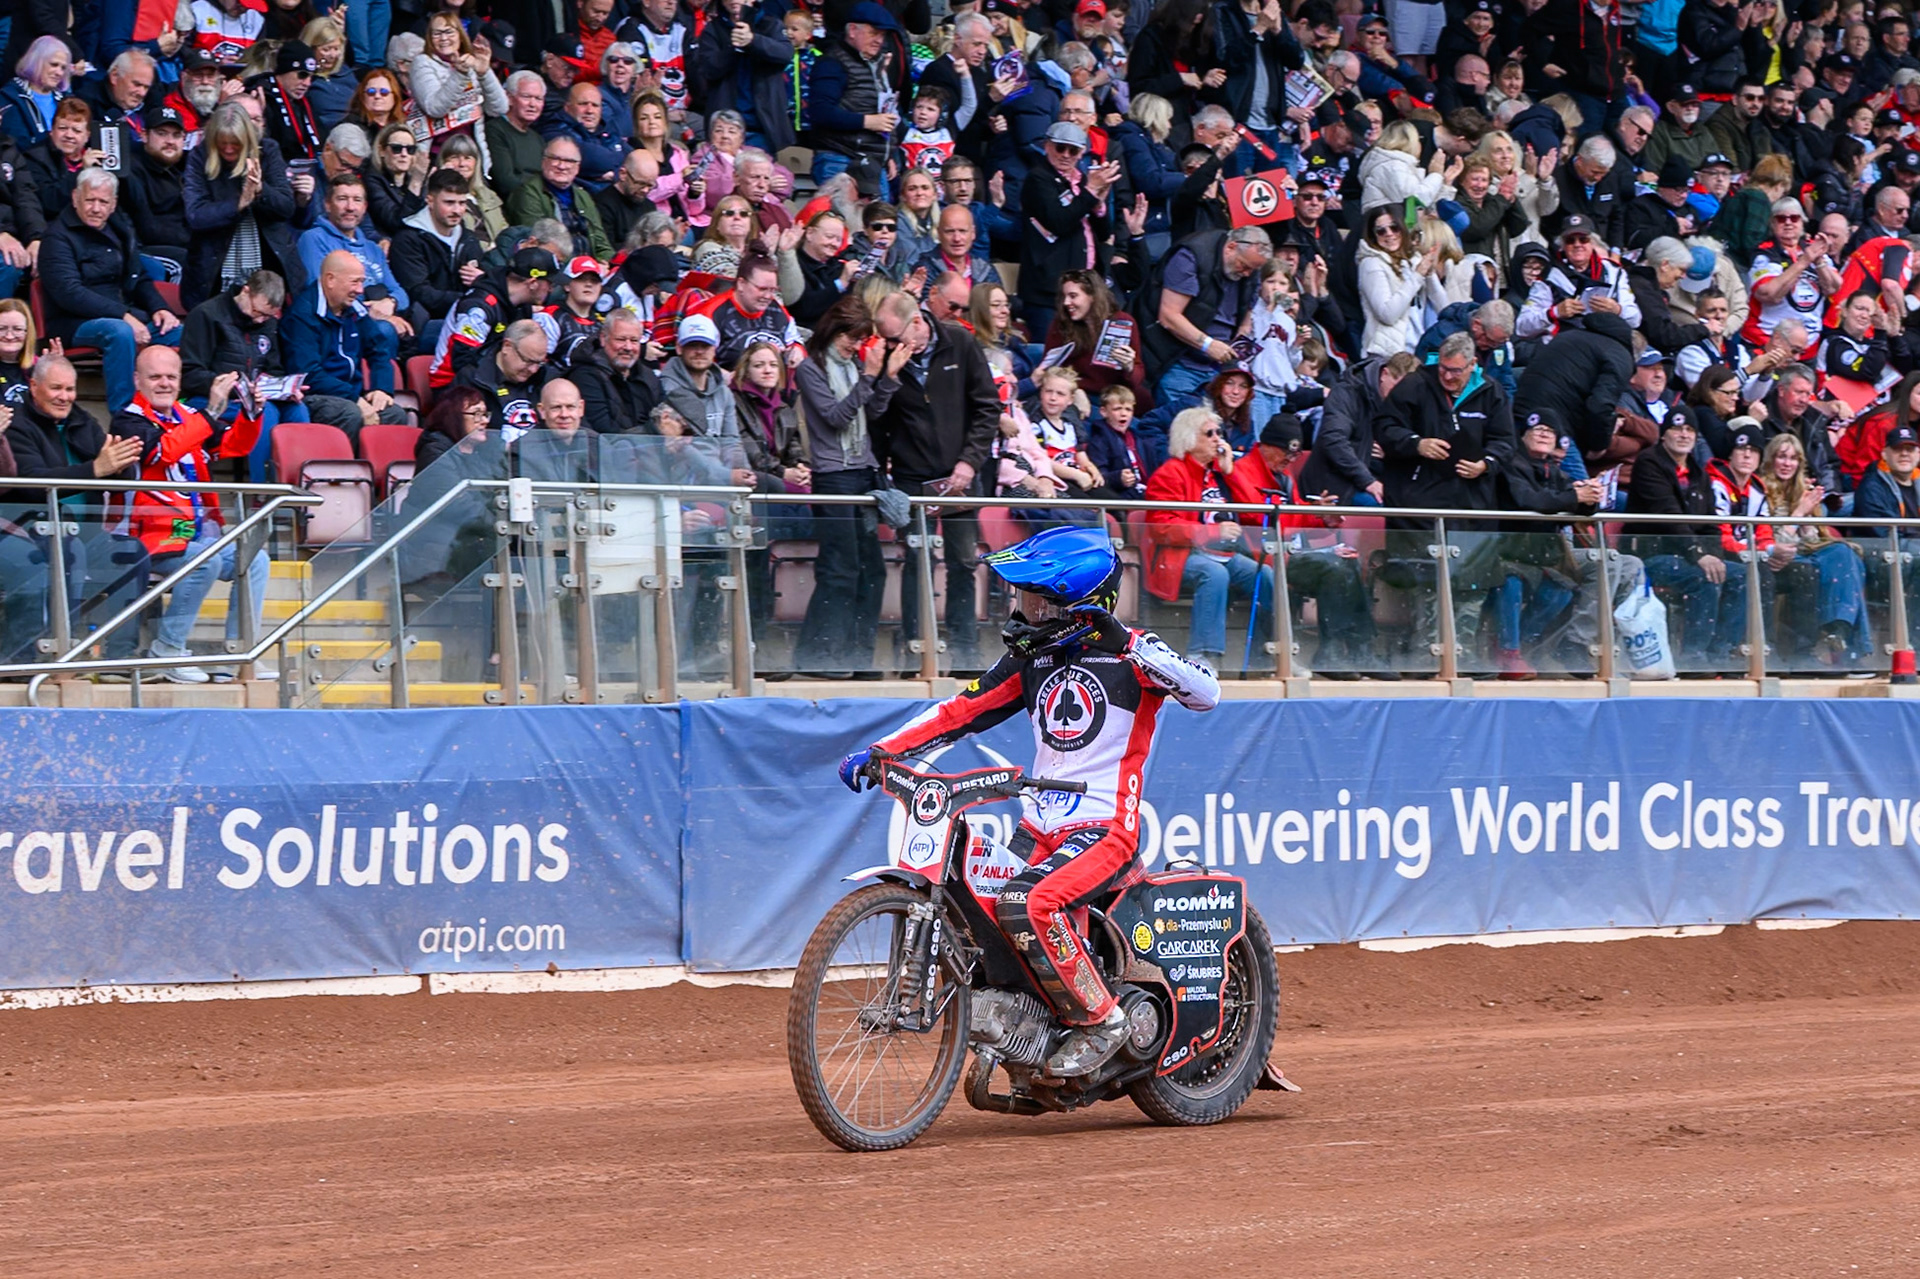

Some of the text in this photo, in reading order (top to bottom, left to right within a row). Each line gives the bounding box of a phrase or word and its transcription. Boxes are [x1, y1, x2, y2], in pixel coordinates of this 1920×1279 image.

[1040, 669, 1103, 705] BELLE UE ACES
[1451, 782, 1619, 855] World
[1640, 780, 1784, 850] Class
[217, 804, 569, 889] Solutions
[911, 842, 931, 853] ATPI
[982, 865, 1015, 879] ANLAS
[418, 918, 565, 963] atpi.com
[1157, 939, 1220, 956] GARCAREK
